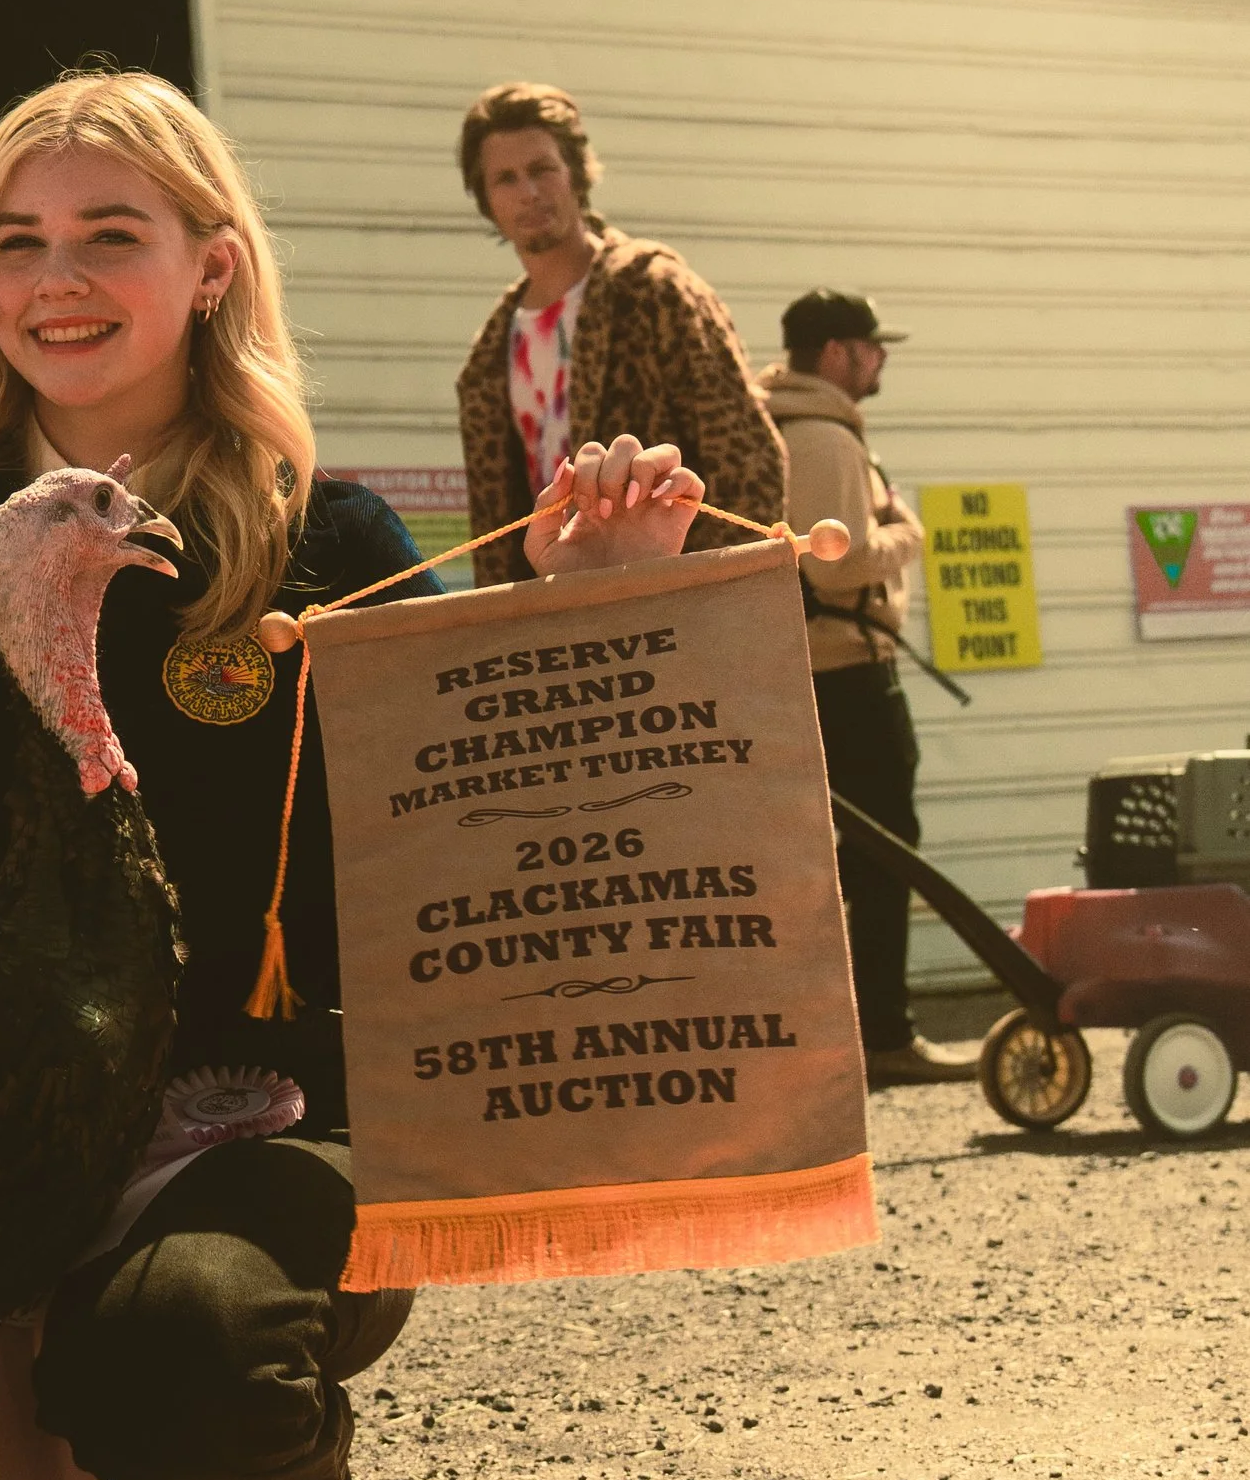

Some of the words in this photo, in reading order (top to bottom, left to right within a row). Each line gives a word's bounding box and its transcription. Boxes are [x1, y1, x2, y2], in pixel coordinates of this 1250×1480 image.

[961, 490, 989, 516] NO
[933, 525, 1022, 554] ALCOHOL
[939, 561, 1022, 590] BEYOND
[962, 597, 1008, 624] THIS
[203, 651, 241, 668] FFA
[435, 627, 678, 696] RESERVE
[958, 631, 1017, 660] POINT
[186, 687, 249, 708] EDUCATION
[464, 670, 656, 723] GRAND
[414, 700, 718, 774] CHAMPION
[388, 758, 573, 818] MARKET
[579, 738, 754, 780] TURKEY
[515, 828, 645, 872] 2026
[415, 864, 758, 934] CLACKAMAS
[408, 925, 635, 984] COUNTY
[645, 913, 778, 951] FAIR
[413, 1029, 556, 1081] 58TH
[572, 1013, 798, 1061] ANNUAL
[482, 1067, 738, 1122] AUCTION
